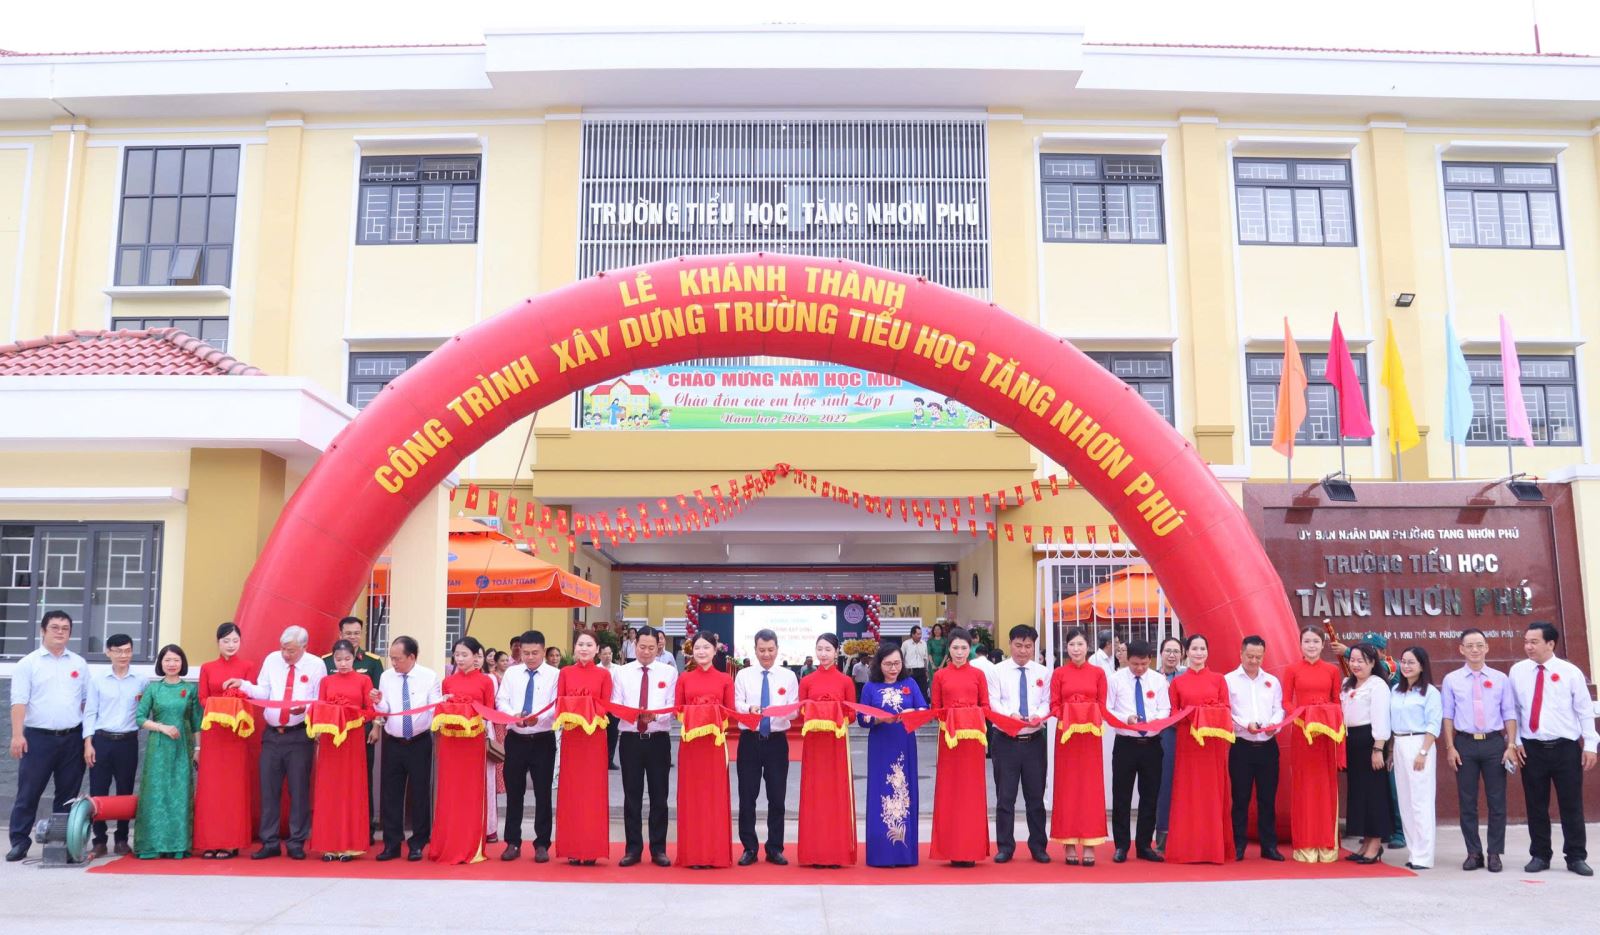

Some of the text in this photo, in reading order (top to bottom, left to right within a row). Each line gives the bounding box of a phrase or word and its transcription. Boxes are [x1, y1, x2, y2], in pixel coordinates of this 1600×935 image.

[590, 192, 979, 230] TRƯỜNG TIỂU HỌC TĂNG NHƠN PHÚ
[619, 262, 907, 309] LỄ KHÁNH THÀNH
[667, 371, 716, 387] CHÀO
[721, 370, 774, 387] MỪNG
[779, 371, 819, 387] NĂM
[825, 372, 862, 389] HỌC
[374, 294, 1188, 537] CÔNG TRÌNH XÂY DỰNG TRƯỜNG TIỂU HỌC TĂNG NHƠN PHÚ
[674, 392, 895, 411] Chào đón các em học sinh Lớp 1
[1315, 529, 1336, 540] BAN
[1339, 527, 1367, 540] NHÂN
[1392, 525, 1435, 540] PHƯỜNG
[1467, 527, 1496, 539] NHƠN
[1498, 526, 1520, 539] PHÚ
[1324, 547, 1499, 576] TRƯỜNG TIỂU HỌC
[1296, 579, 1533, 617] TĂNG NHƠN PHÚ
